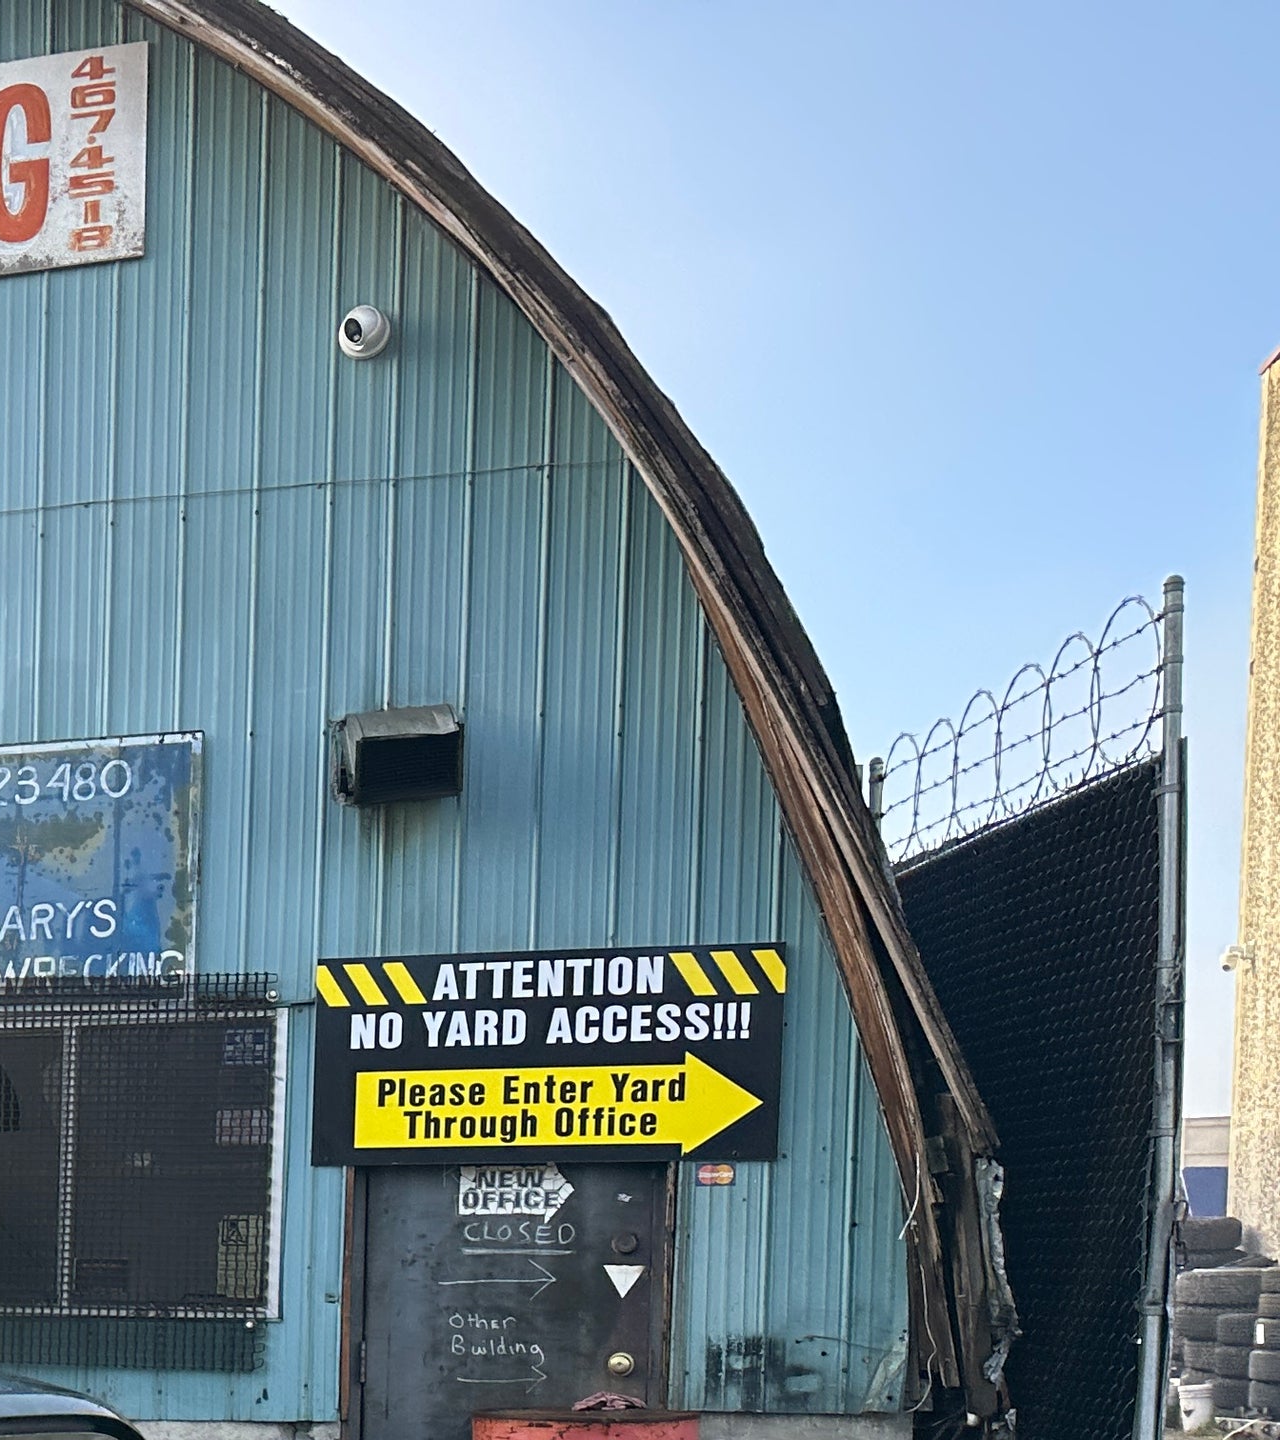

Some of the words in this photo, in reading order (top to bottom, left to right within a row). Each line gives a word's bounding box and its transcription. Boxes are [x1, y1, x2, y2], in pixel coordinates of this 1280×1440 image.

[432, 956, 665, 1002] ATTENTION
[349, 1013, 403, 1051] NO
[422, 1008, 528, 1048] YARD
[545, 1002, 752, 1045] ACCESS!!!
[377, 1077, 486, 1108] Please
[503, 1073, 594, 1106] Enter
[611, 1071, 687, 1103] Yard
[404, 1109, 538, 1144] Through
[554, 1106, 658, 1138] Office
[476, 1168, 544, 1188] NEW
[462, 1188, 561, 1210] OFFICE
[464, 1221, 576, 1245] CLOSED
[451, 1335, 545, 1367] Building
